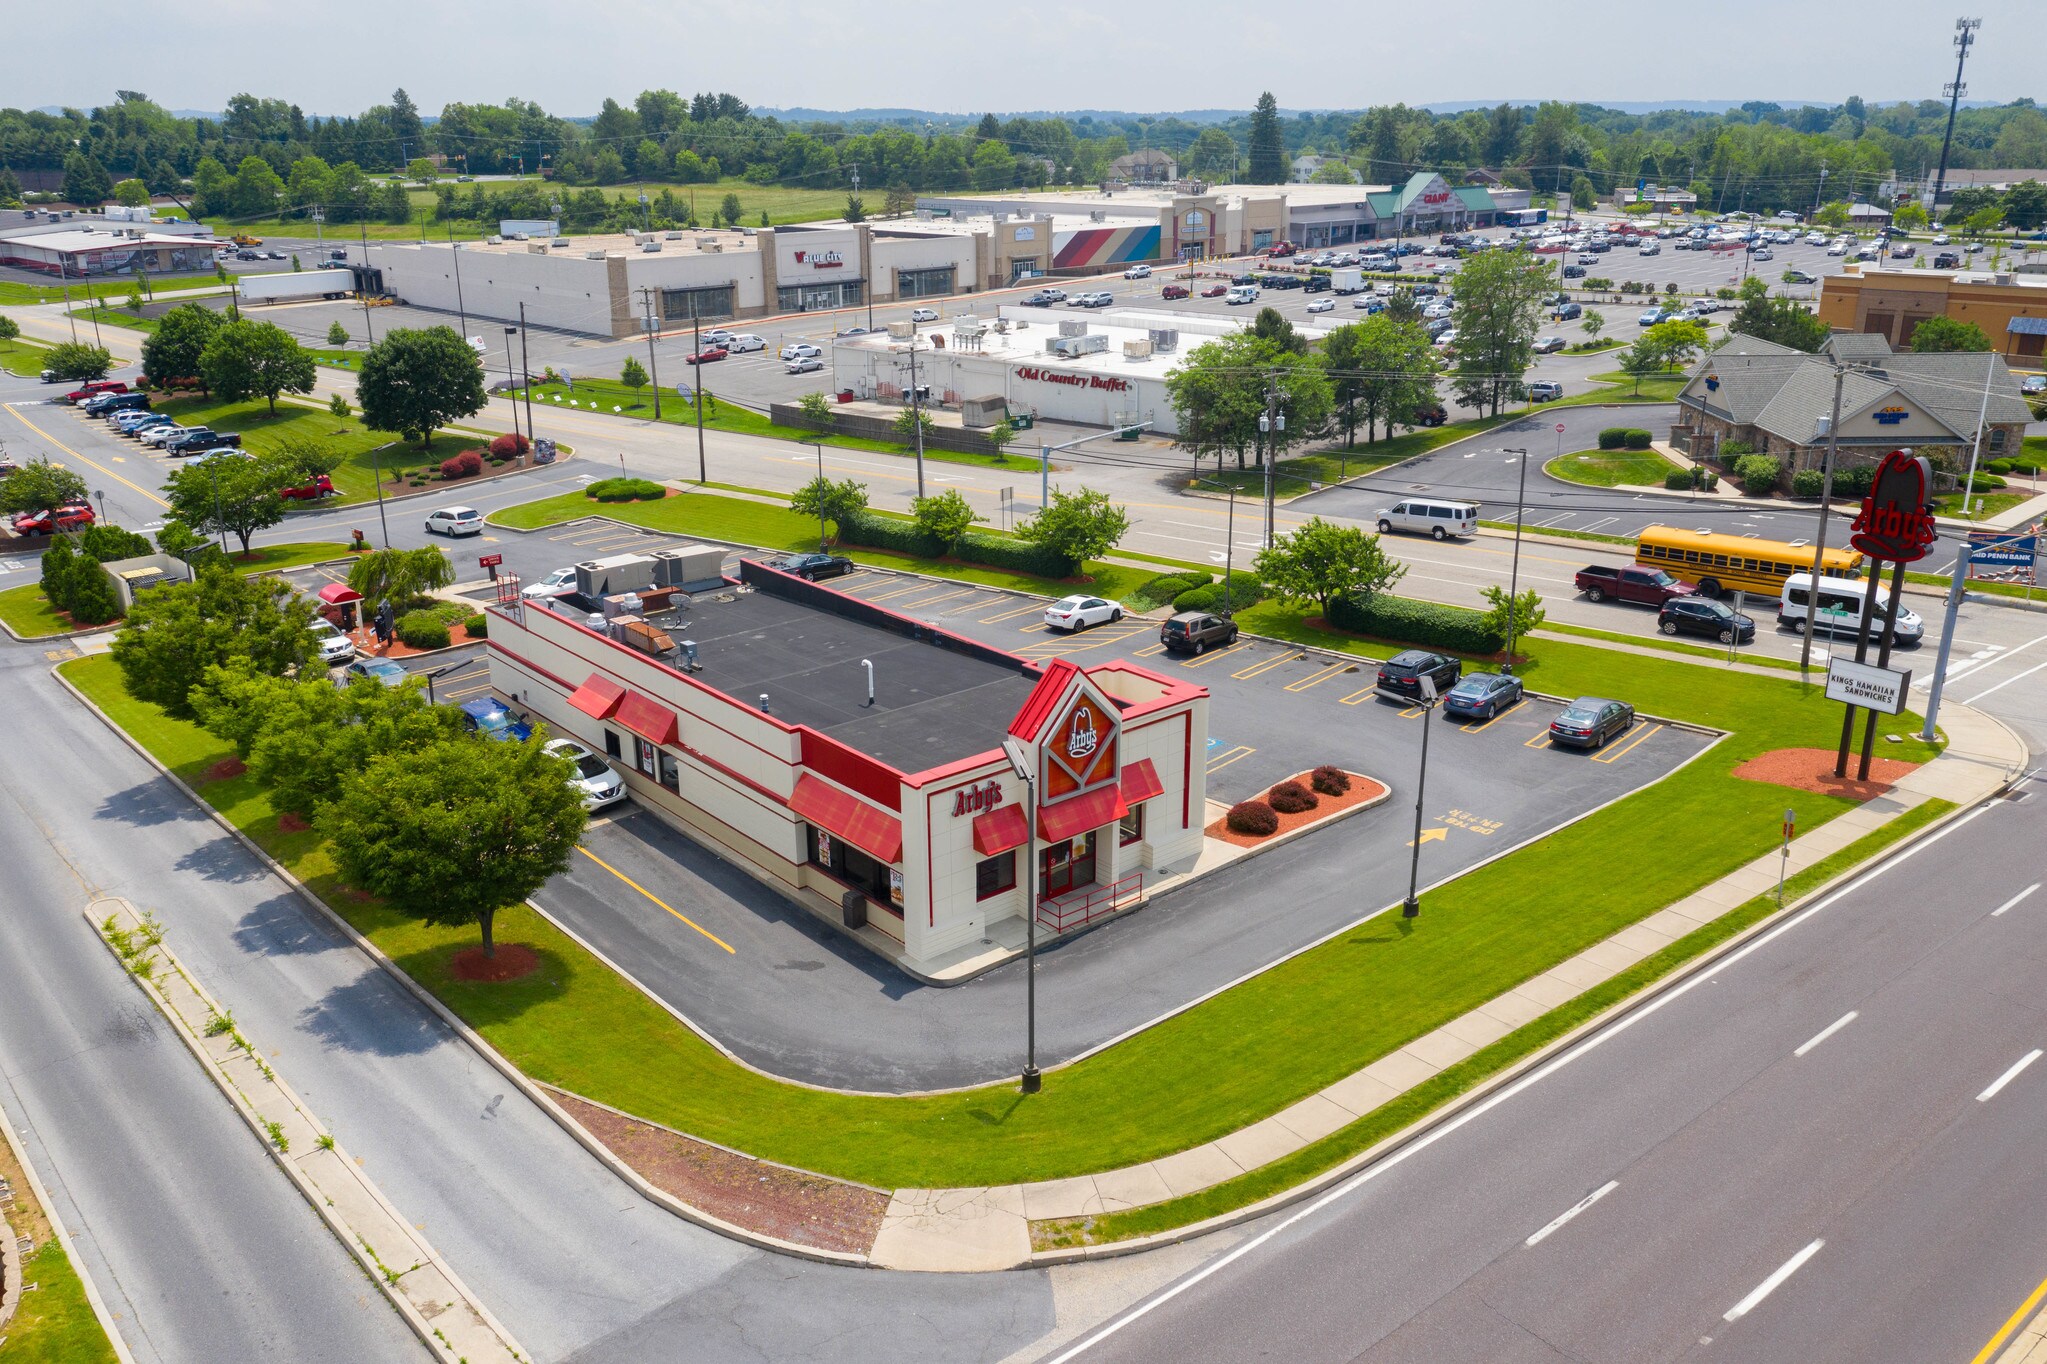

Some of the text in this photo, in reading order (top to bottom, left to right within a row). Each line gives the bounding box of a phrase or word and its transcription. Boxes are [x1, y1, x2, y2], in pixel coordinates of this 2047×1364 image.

[1424, 193, 1449, 204] GIANT
[1018, 367, 1128, 392] Old Country Buffet
[1851, 497, 1936, 549] Arby's
[1831, 674, 1895, 696] KINGS HAWAIIAN
[1844, 686, 1893, 704] SANDWICHES
[1069, 728, 1097, 751] Arby's
[952, 780, 1003, 817] Arby's
